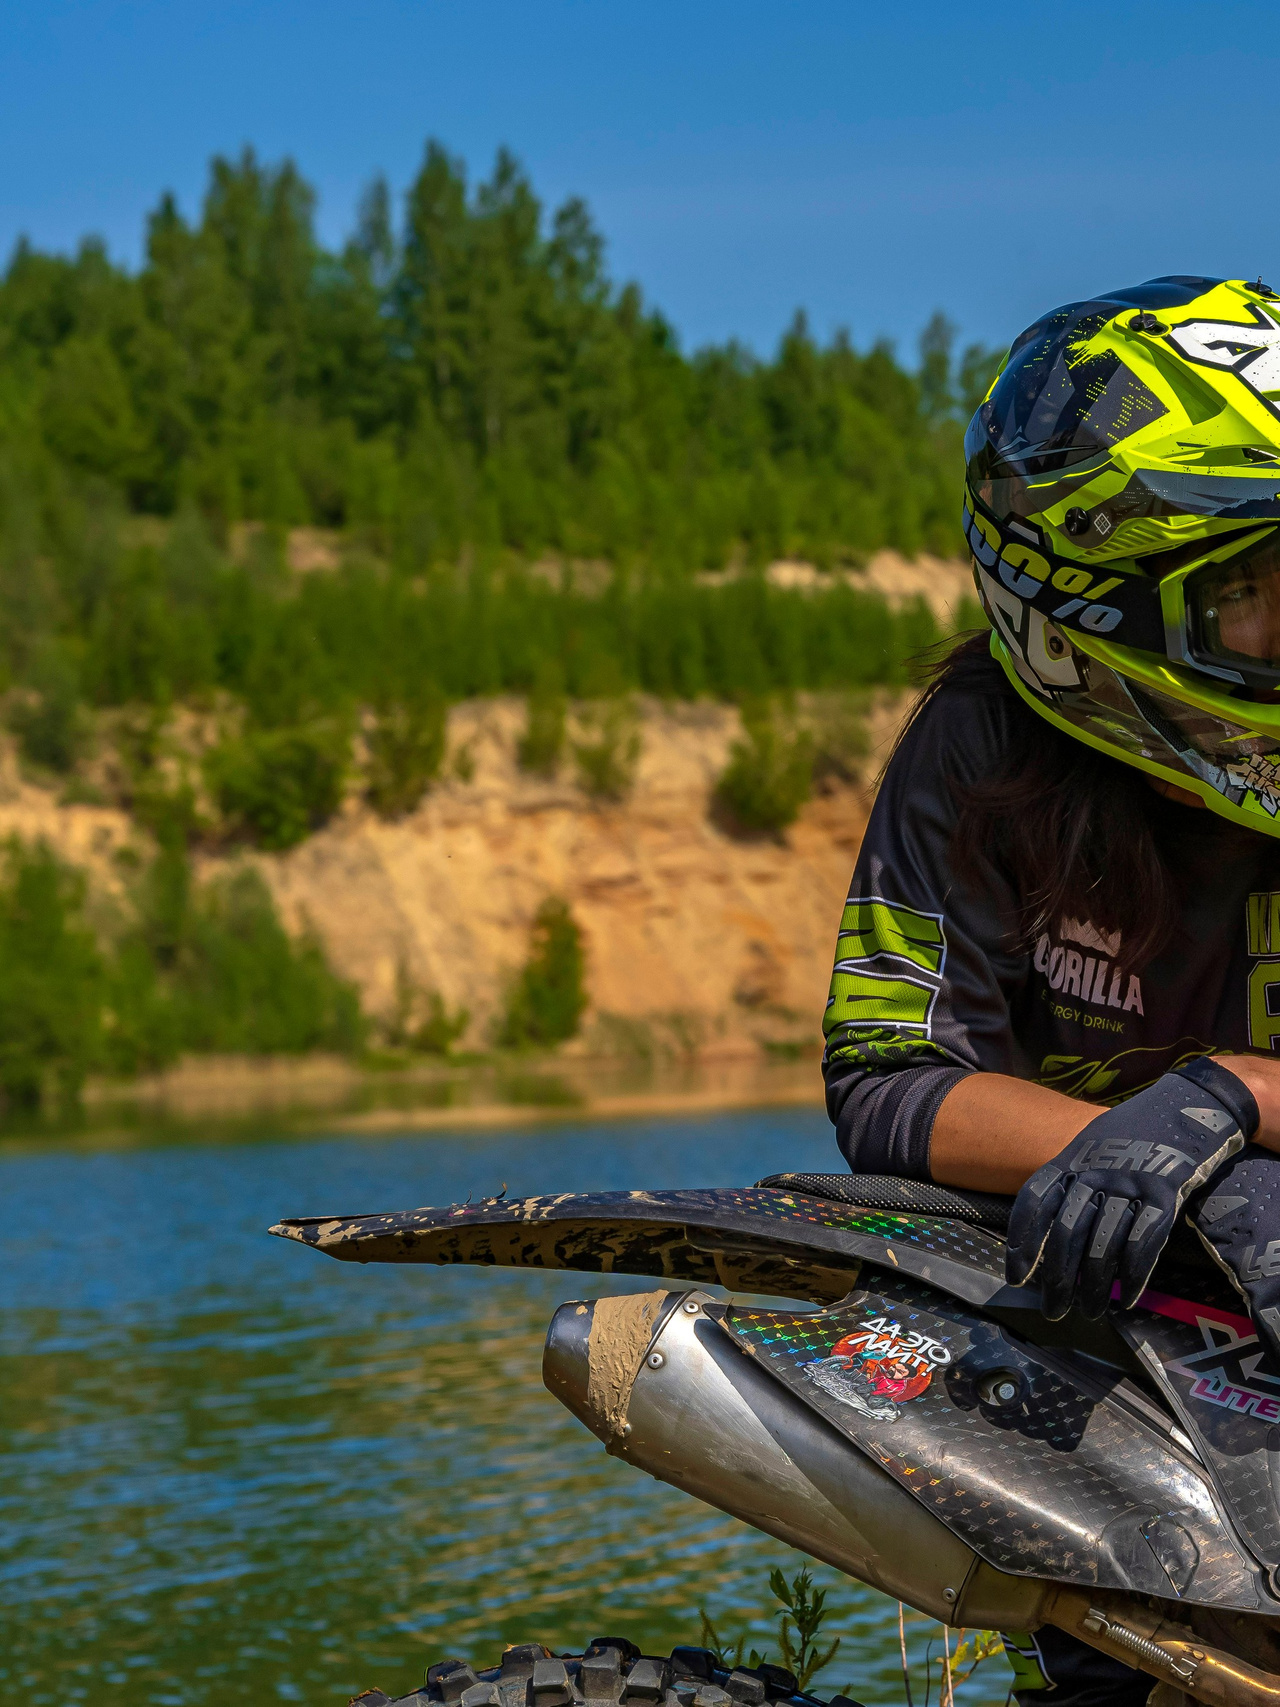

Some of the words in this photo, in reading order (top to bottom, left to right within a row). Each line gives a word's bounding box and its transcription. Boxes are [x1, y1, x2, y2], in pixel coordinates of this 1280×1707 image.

[1032, 932, 1145, 1017] GORILLA
[1083, 1013, 1126, 1034] DRINK
[1069, 1138, 1198, 1178] LEATT
[846, 1333, 938, 1377] ЛАЙТ!
[858, 1317, 902, 1340] ДА
[898, 1330, 952, 1364] ЭТО
